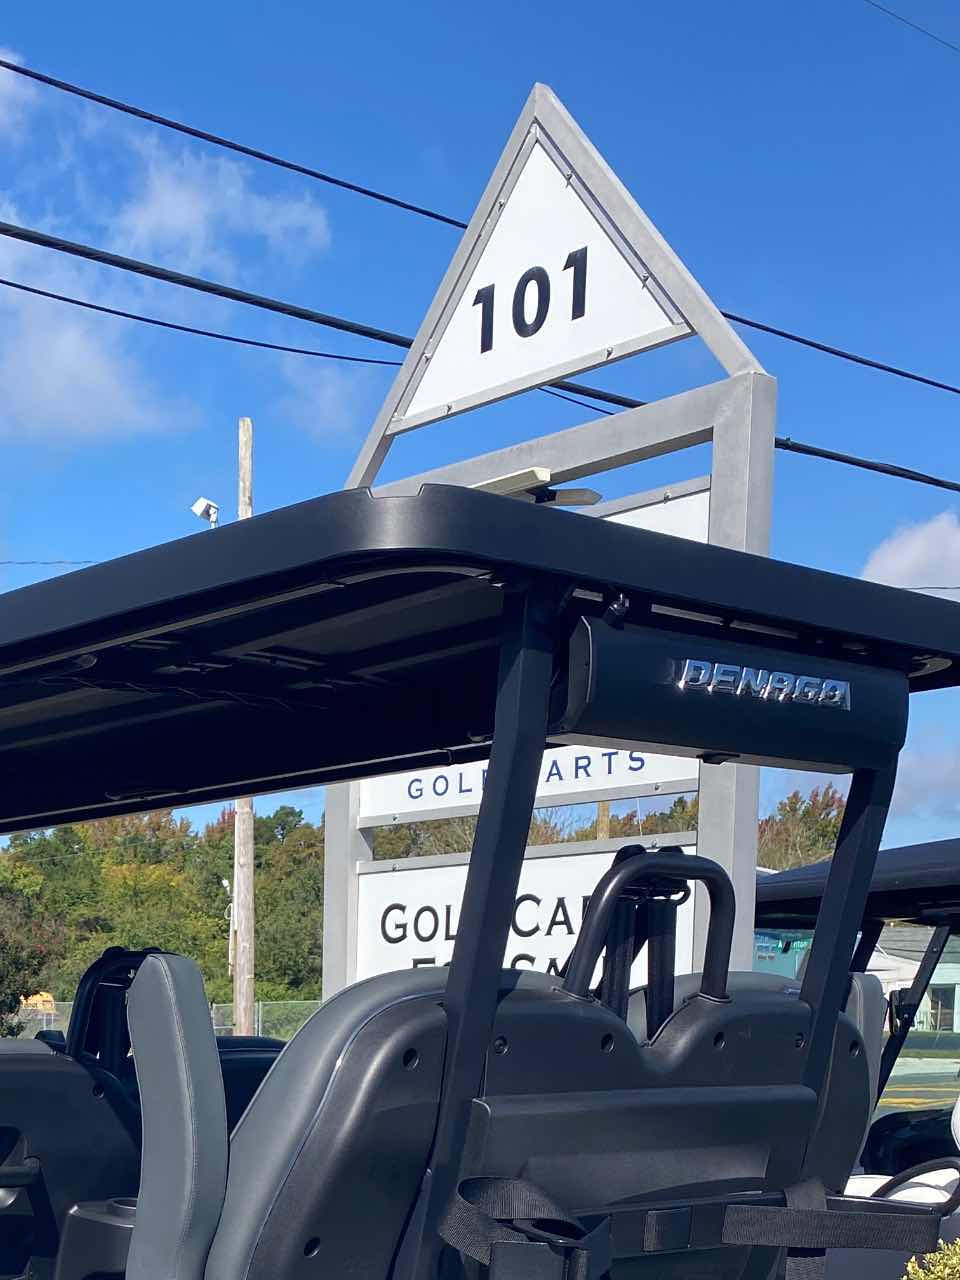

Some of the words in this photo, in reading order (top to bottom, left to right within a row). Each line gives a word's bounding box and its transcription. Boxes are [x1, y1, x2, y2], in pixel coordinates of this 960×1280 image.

[472, 246, 588, 354] 101
[677, 658, 852, 711] DENAGO
[545, 751, 646, 783] ARTS
[380, 902, 458, 944] GOL
